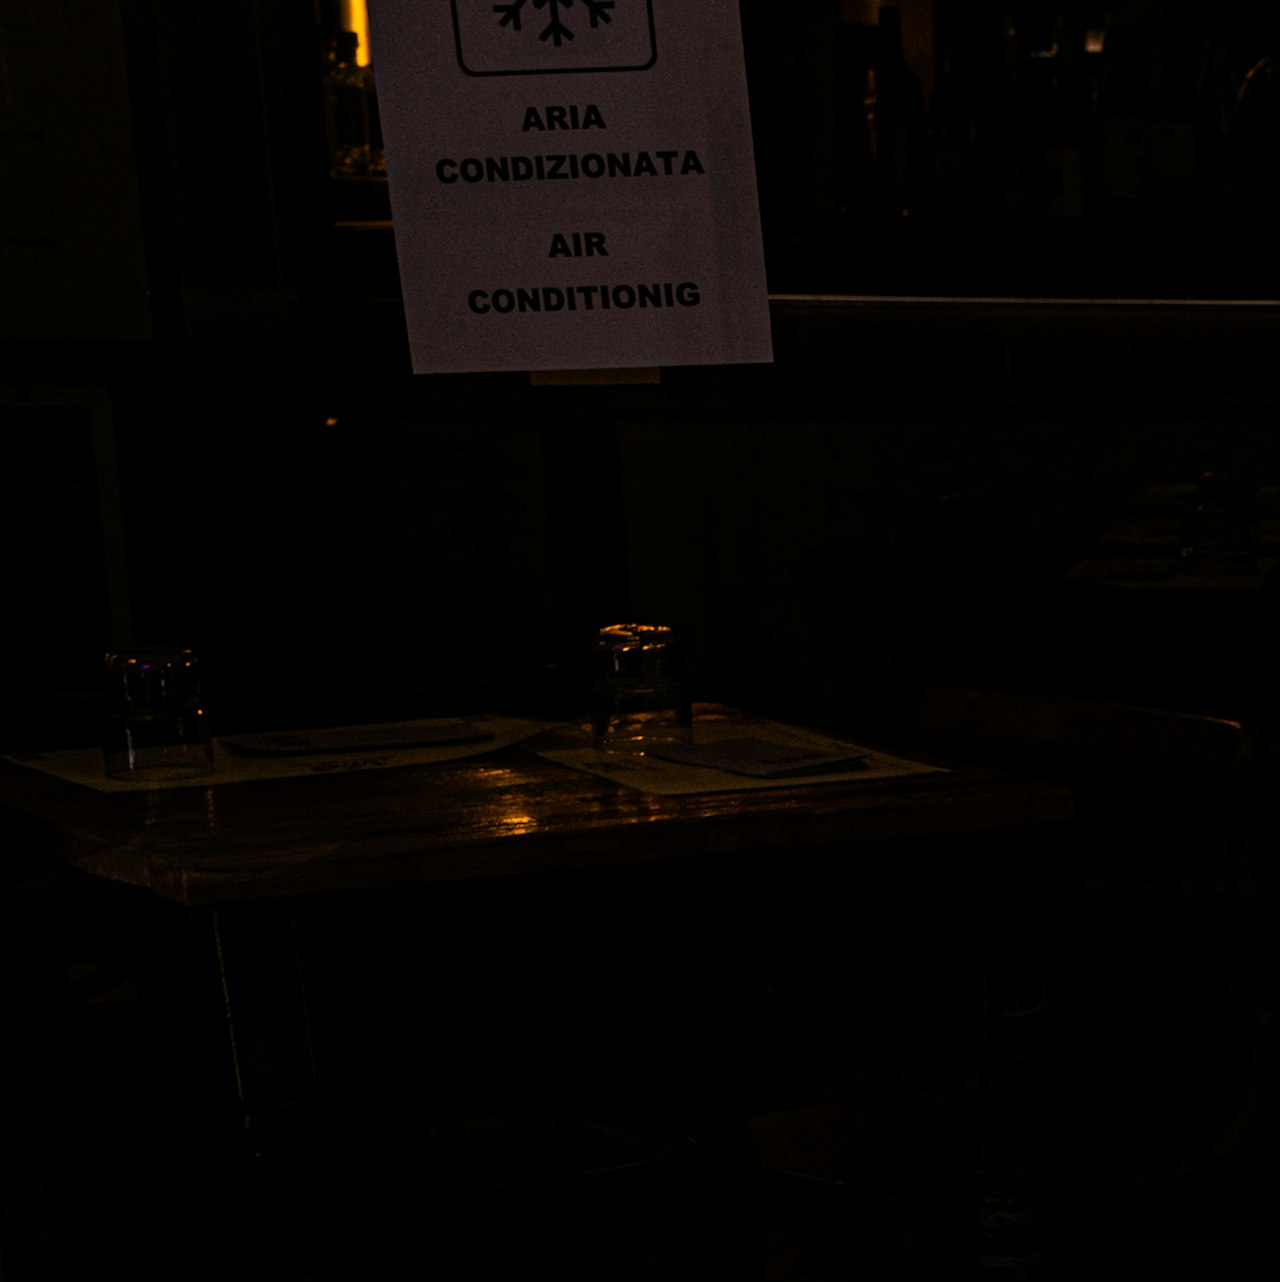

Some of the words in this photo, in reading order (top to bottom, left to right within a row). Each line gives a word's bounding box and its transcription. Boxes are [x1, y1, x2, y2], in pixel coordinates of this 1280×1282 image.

[522, 105, 606, 131] ARIA
[436, 150, 704, 184] CONDIZIONATA
[548, 232, 608, 258] AIR
[468, 282, 700, 314] CONDITIONIG
